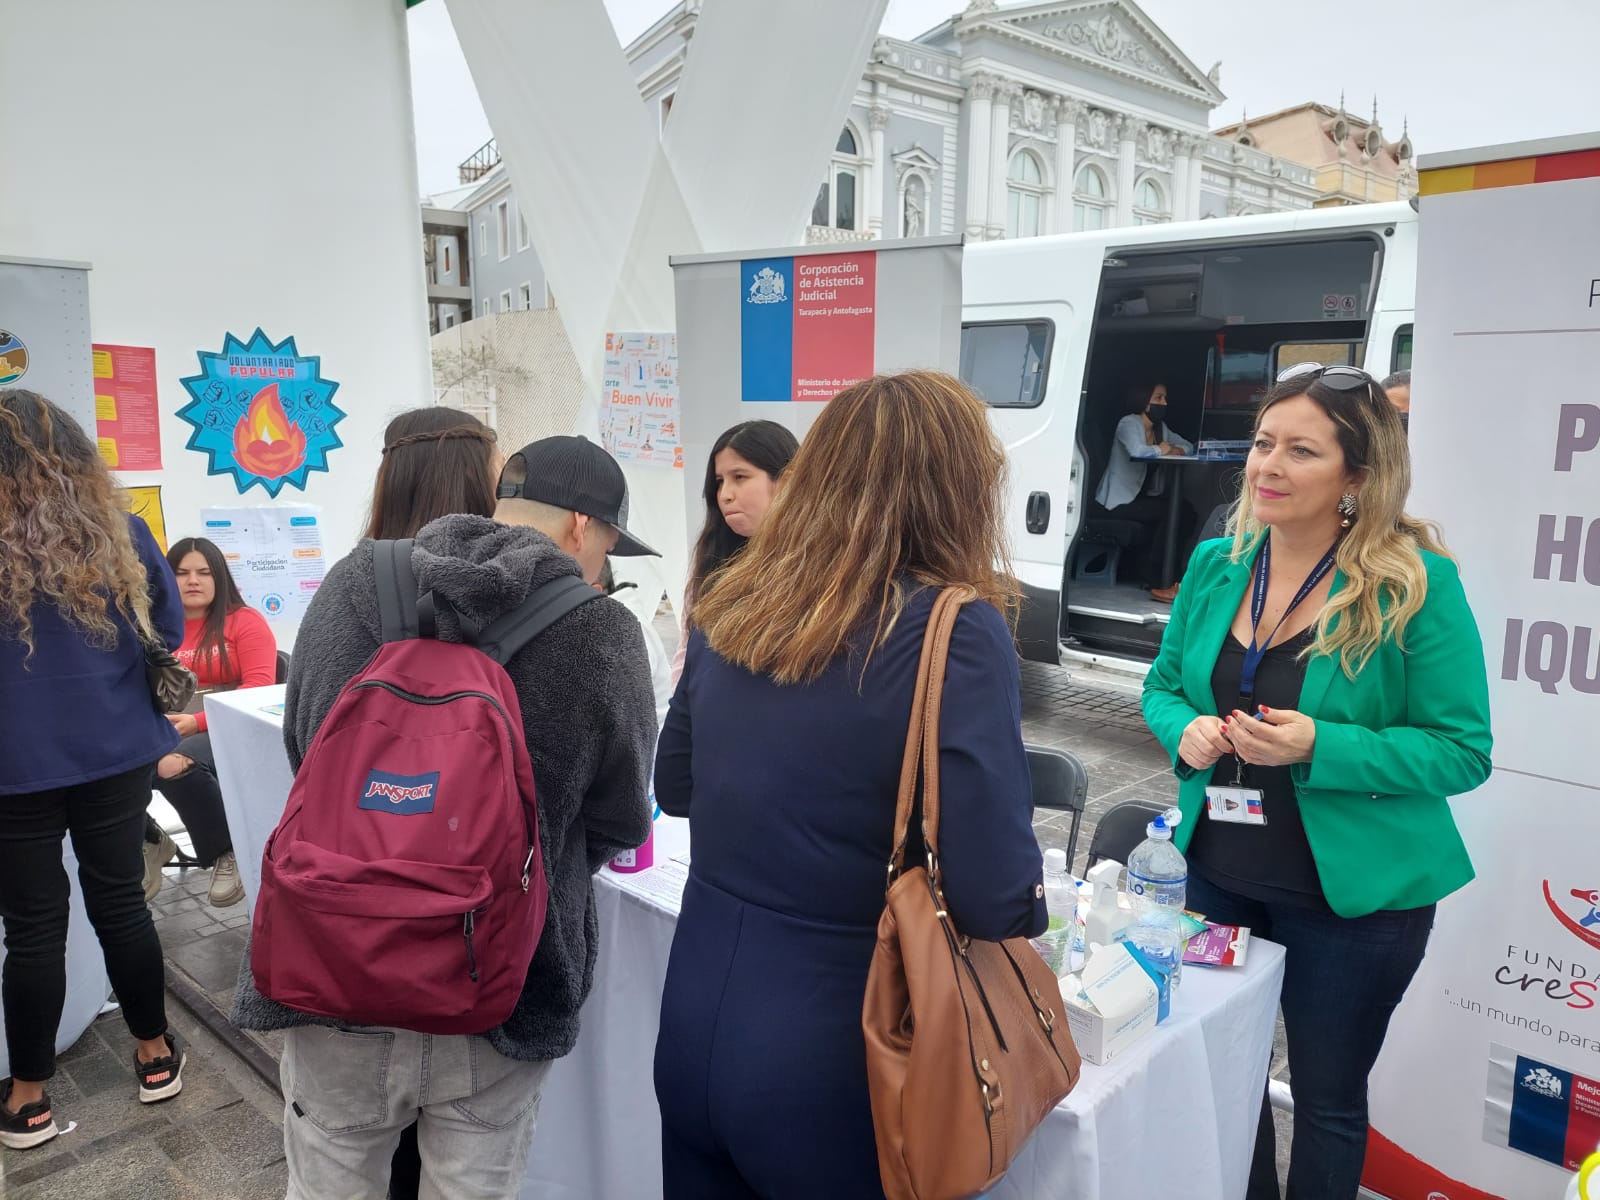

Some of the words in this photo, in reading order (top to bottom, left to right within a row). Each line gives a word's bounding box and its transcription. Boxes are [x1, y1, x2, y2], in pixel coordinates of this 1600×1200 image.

[800, 262, 859, 276] Corporación
[800, 278, 811, 288] de
[814, 275, 864, 287] Asistencia
[799, 290, 837, 301] Judicial
[229, 356, 295, 367] VOLUNTARIADO
[230, 366, 295, 378] POPULAR
[612, 389, 641, 405] Buen
[645, 391, 674, 408] Vivir
[1486, 1007, 1553, 1036] mundo
[1558, 1030, 1600, 1052] para
